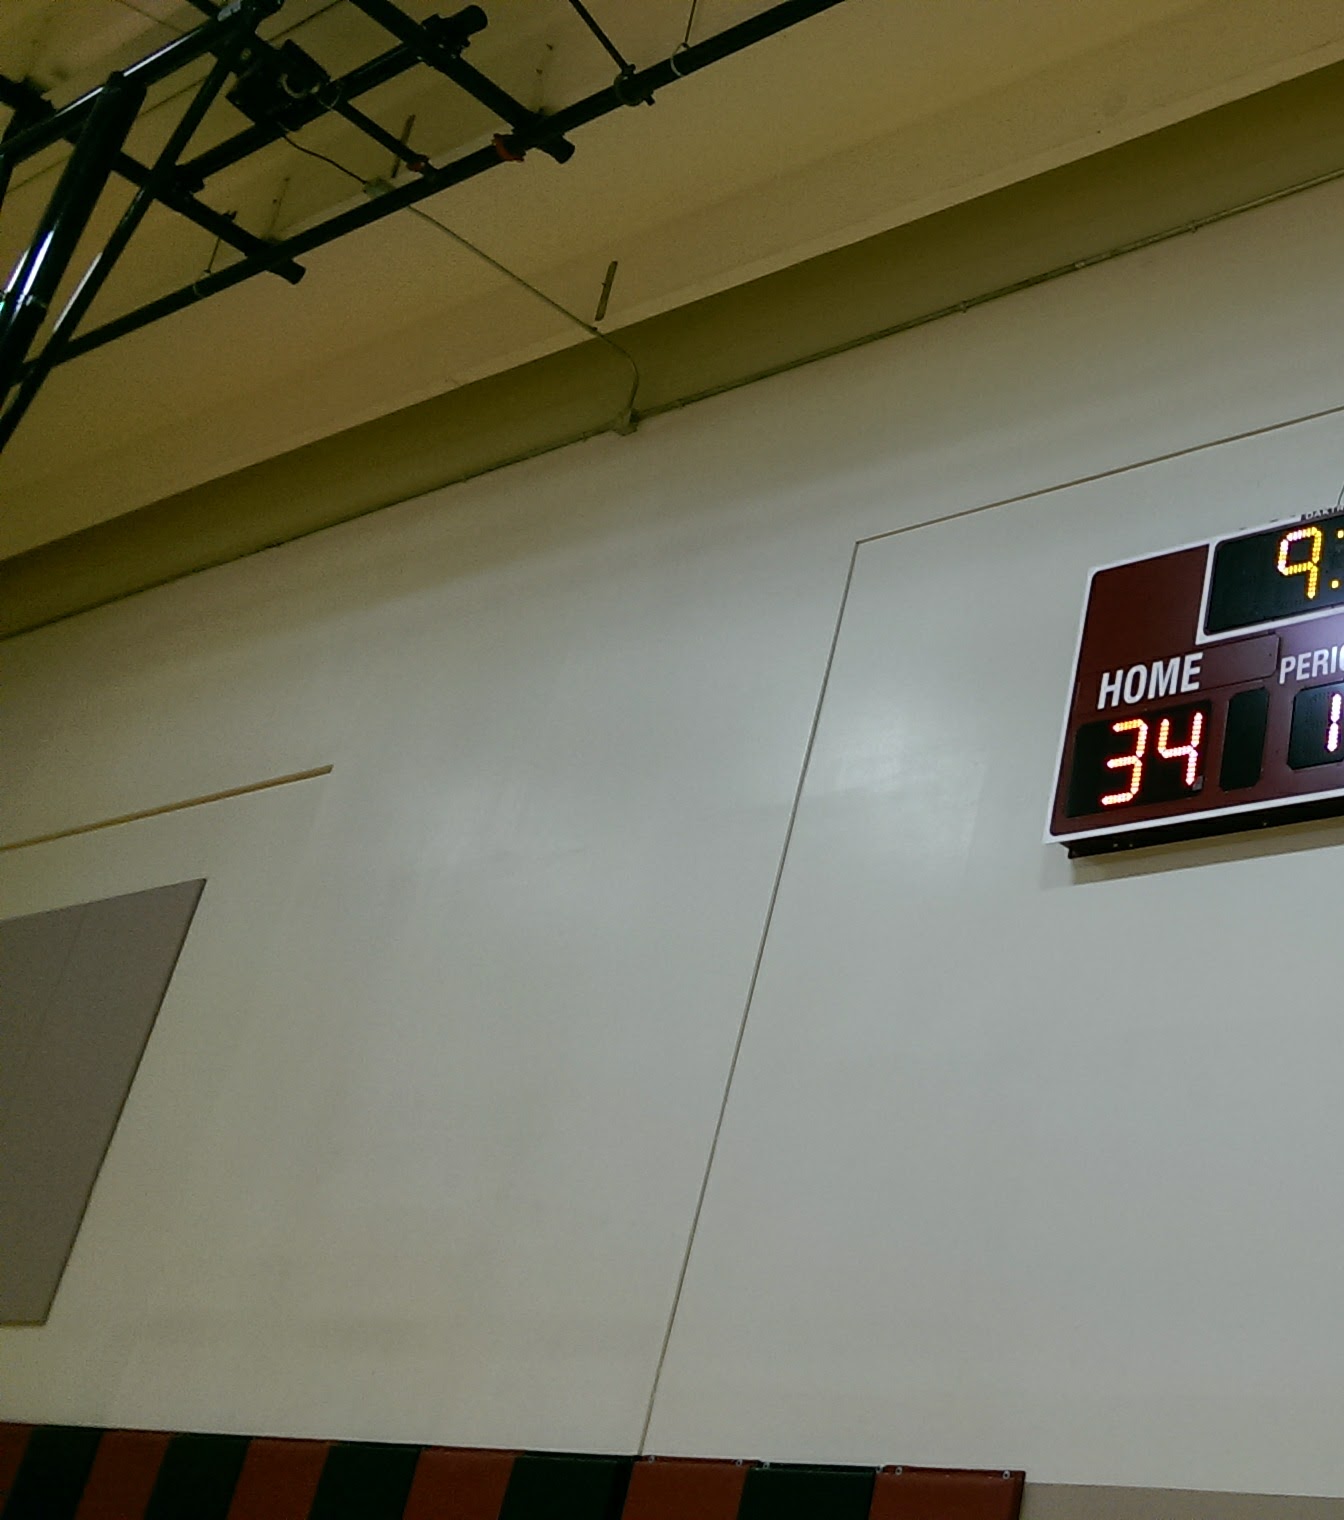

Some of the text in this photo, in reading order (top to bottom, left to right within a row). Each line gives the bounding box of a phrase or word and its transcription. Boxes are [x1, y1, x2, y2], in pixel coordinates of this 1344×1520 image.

[1097, 652, 1203, 710] HOME
[1326, 693, 1342, 752] 1
[1101, 712, 1203, 806] 34
